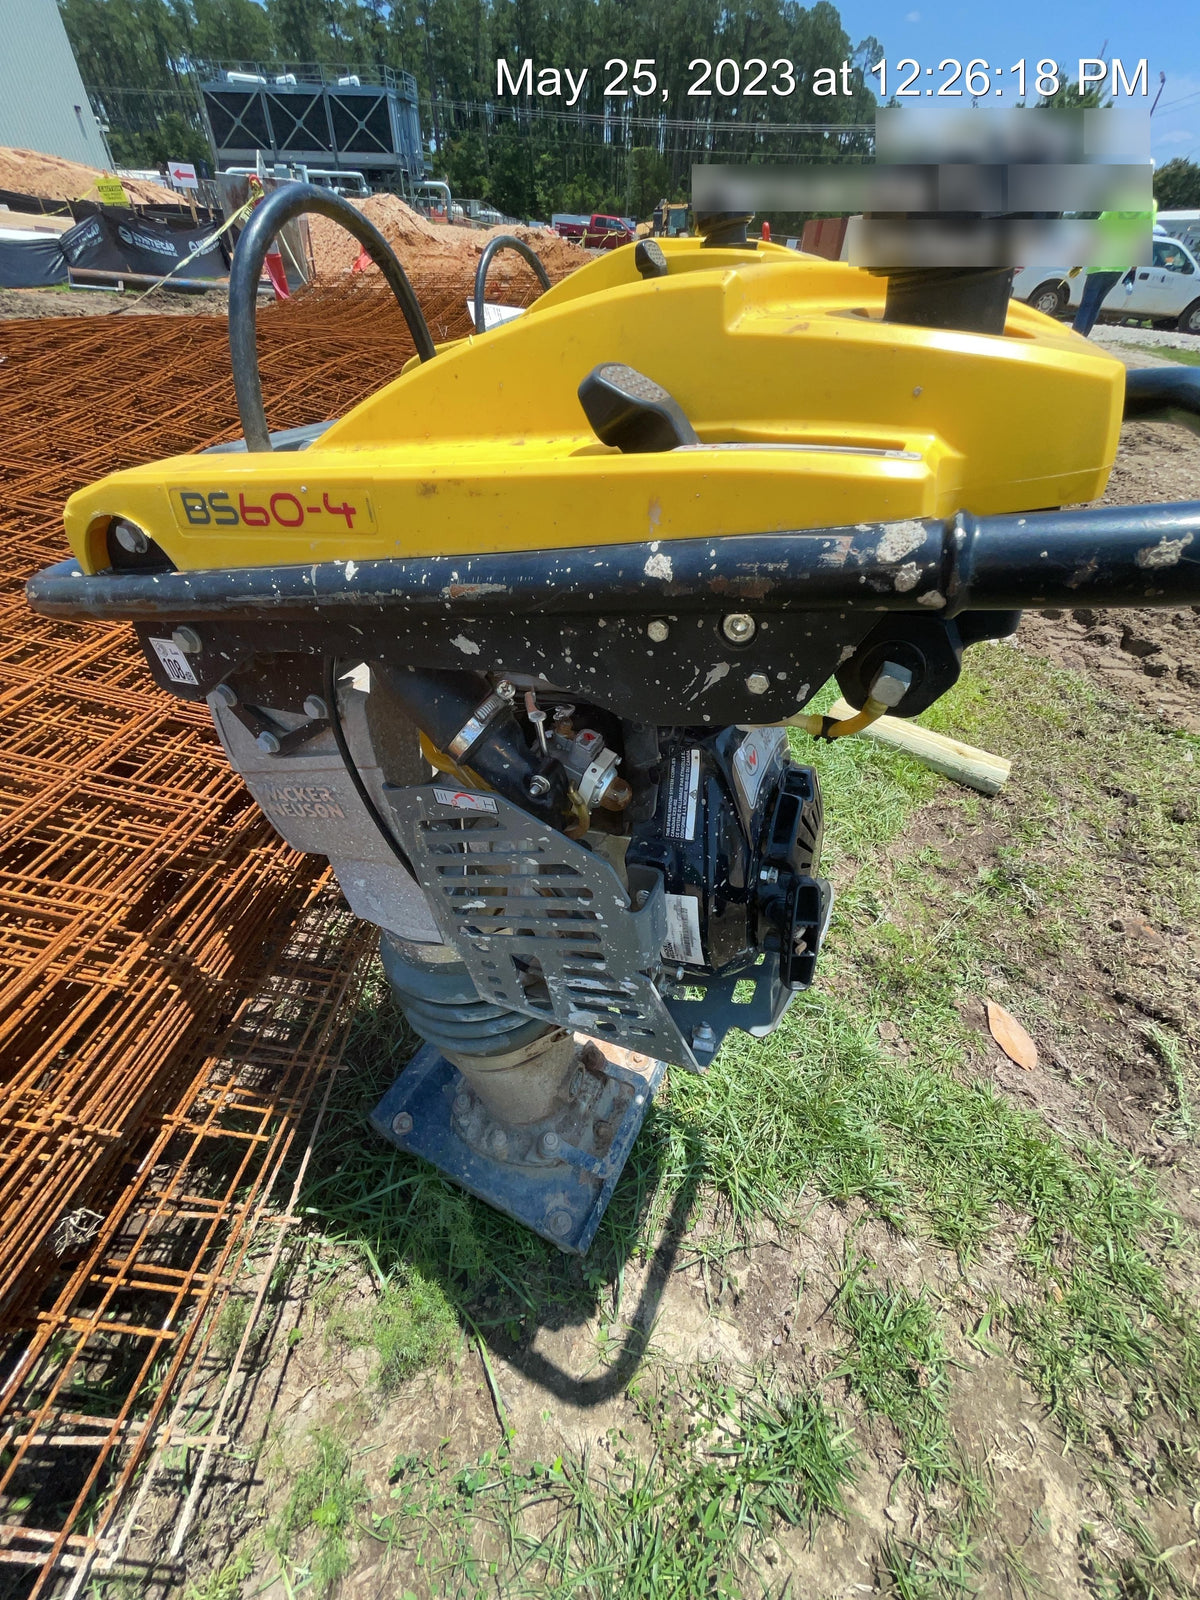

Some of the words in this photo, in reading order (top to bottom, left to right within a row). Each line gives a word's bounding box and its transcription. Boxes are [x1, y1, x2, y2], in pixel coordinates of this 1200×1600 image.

[180, 492, 357, 528] BS60-4
[163, 658, 186, 679] 108
[271, 802, 345, 819] NEUSON
